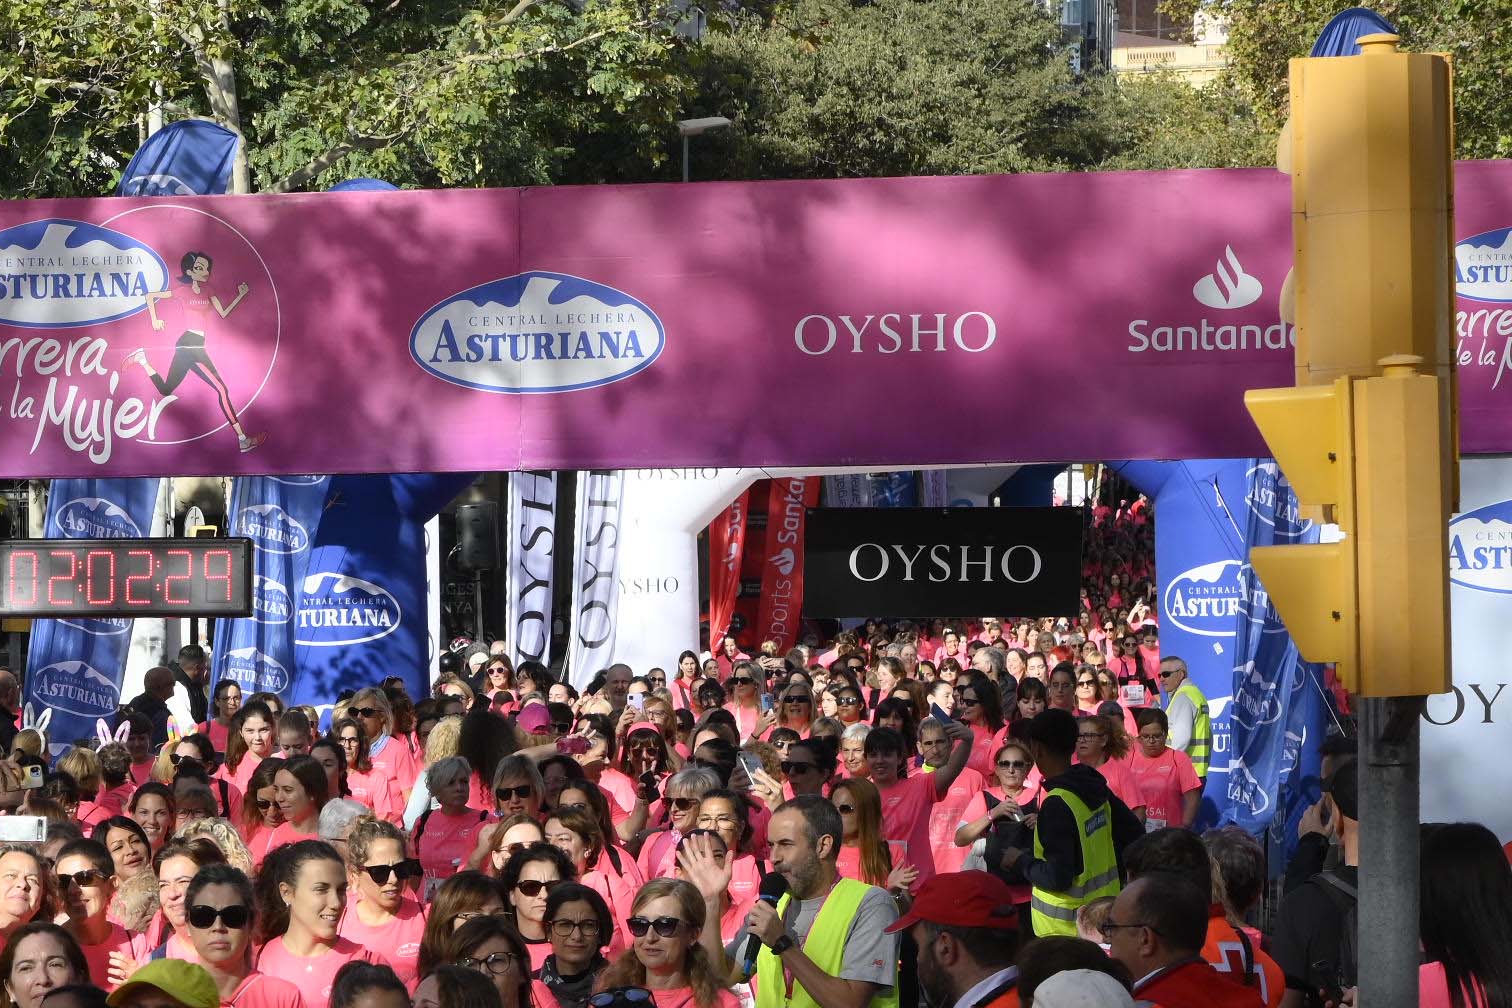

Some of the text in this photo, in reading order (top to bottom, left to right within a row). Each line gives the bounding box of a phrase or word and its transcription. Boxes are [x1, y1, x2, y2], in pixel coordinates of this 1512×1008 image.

[71, 253, 144, 268] LECHERA
[468, 312, 637, 328] CENTRAL LECHERA
[794, 311, 997, 355] OYSHO
[428, 320, 645, 363] ASTURIANA
[1478, 339, 1496, 366] la
[9, 376, 35, 420] la
[29, 370, 180, 465] Mujer
[777, 476, 806, 545] Santa
[9, 549, 233, 605] 02:02:29
[848, 542, 1043, 582] OYSHO
[303, 597, 388, 606] NTRAL LECHERA
[618, 575, 680, 594] YSHO
[299, 608, 393, 628] TURIANA
[1171, 588, 1239, 618] ASTUR
[39, 673, 115, 711] ASTURIANA
